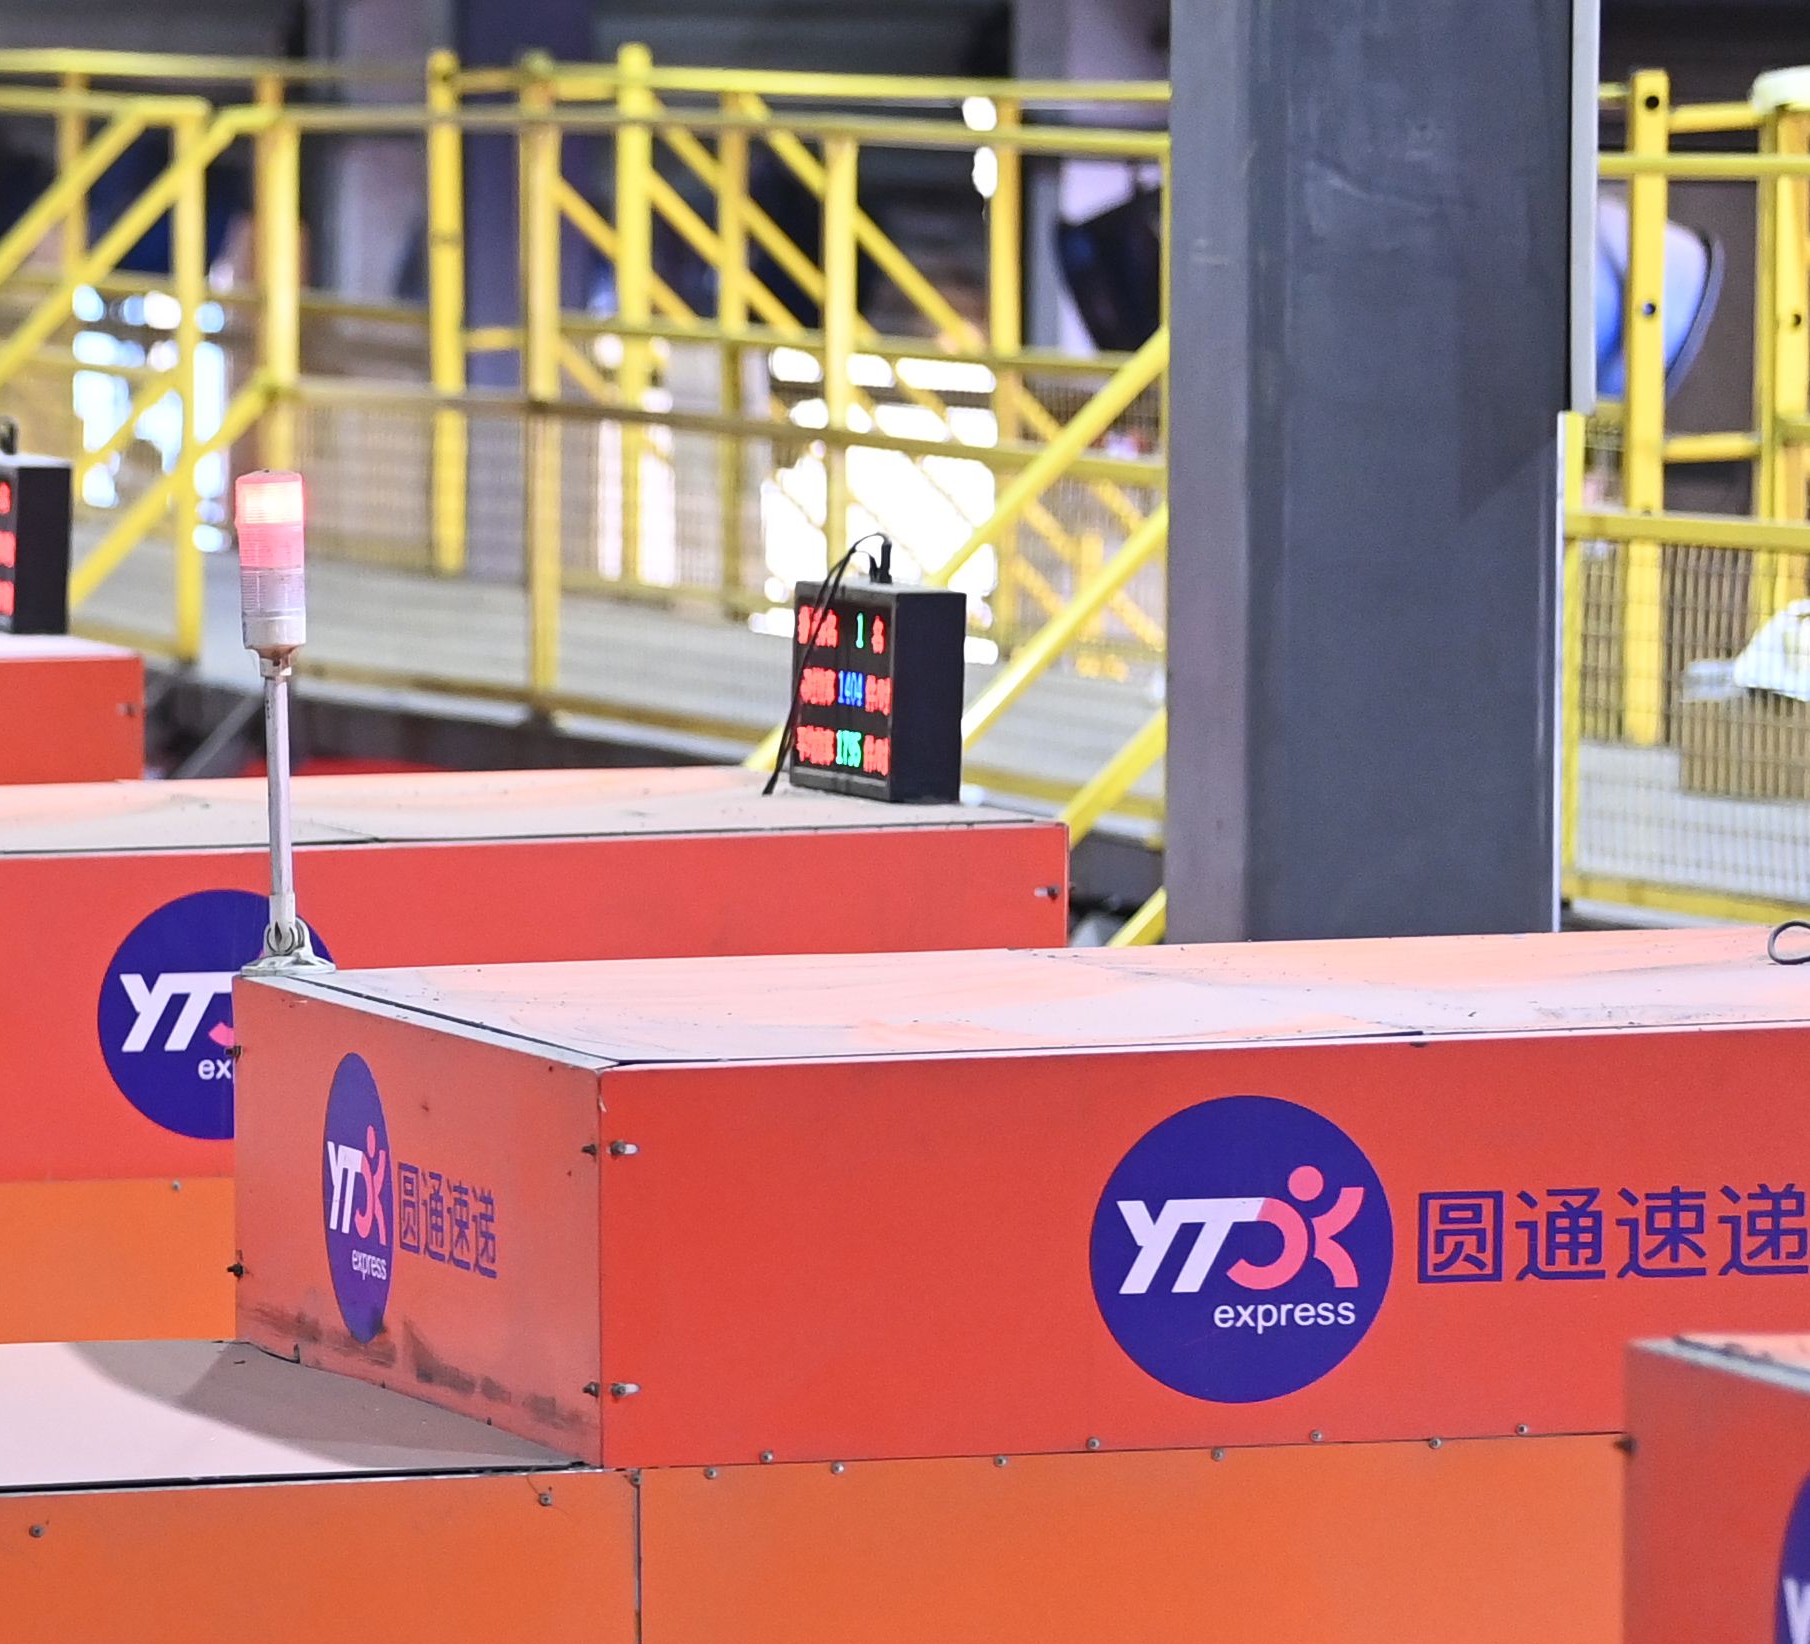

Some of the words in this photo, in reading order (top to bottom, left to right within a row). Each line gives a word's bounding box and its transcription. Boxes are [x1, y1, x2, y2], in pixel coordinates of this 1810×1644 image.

[398, 1162, 498, 1279] 圆通速递
[1418, 1182, 1810, 1284] 圆通速递
[351, 1249, 387, 1281] express
[1213, 1300, 1356, 1334] express
